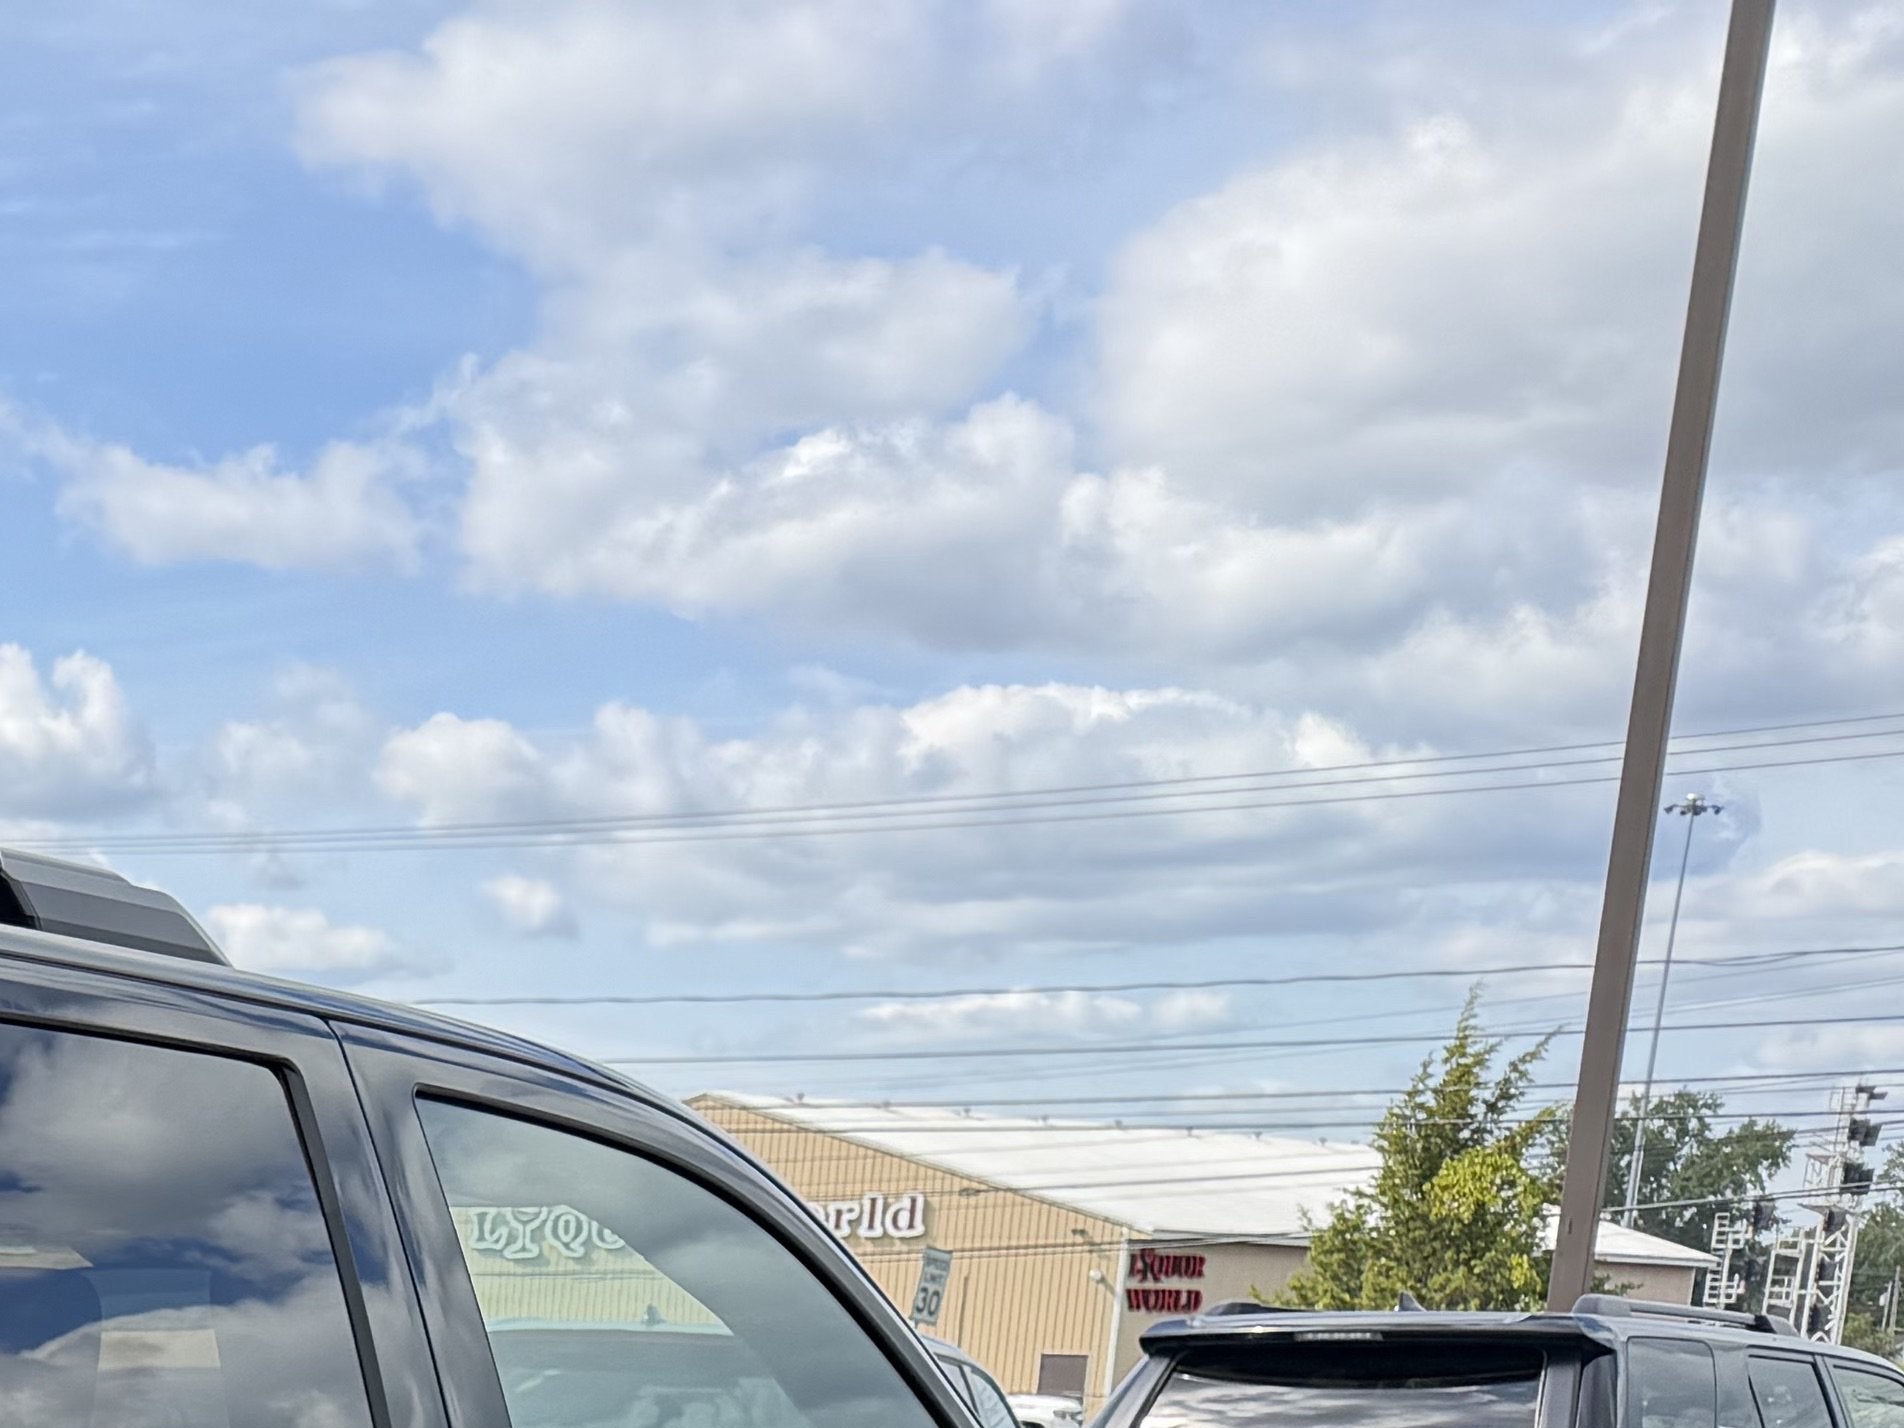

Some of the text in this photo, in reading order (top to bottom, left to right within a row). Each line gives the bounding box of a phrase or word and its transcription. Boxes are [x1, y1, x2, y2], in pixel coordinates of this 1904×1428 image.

[806, 1192, 926, 1239] rld
[915, 1286, 940, 1317] 30
[1126, 1289, 1203, 1313] WORLD
